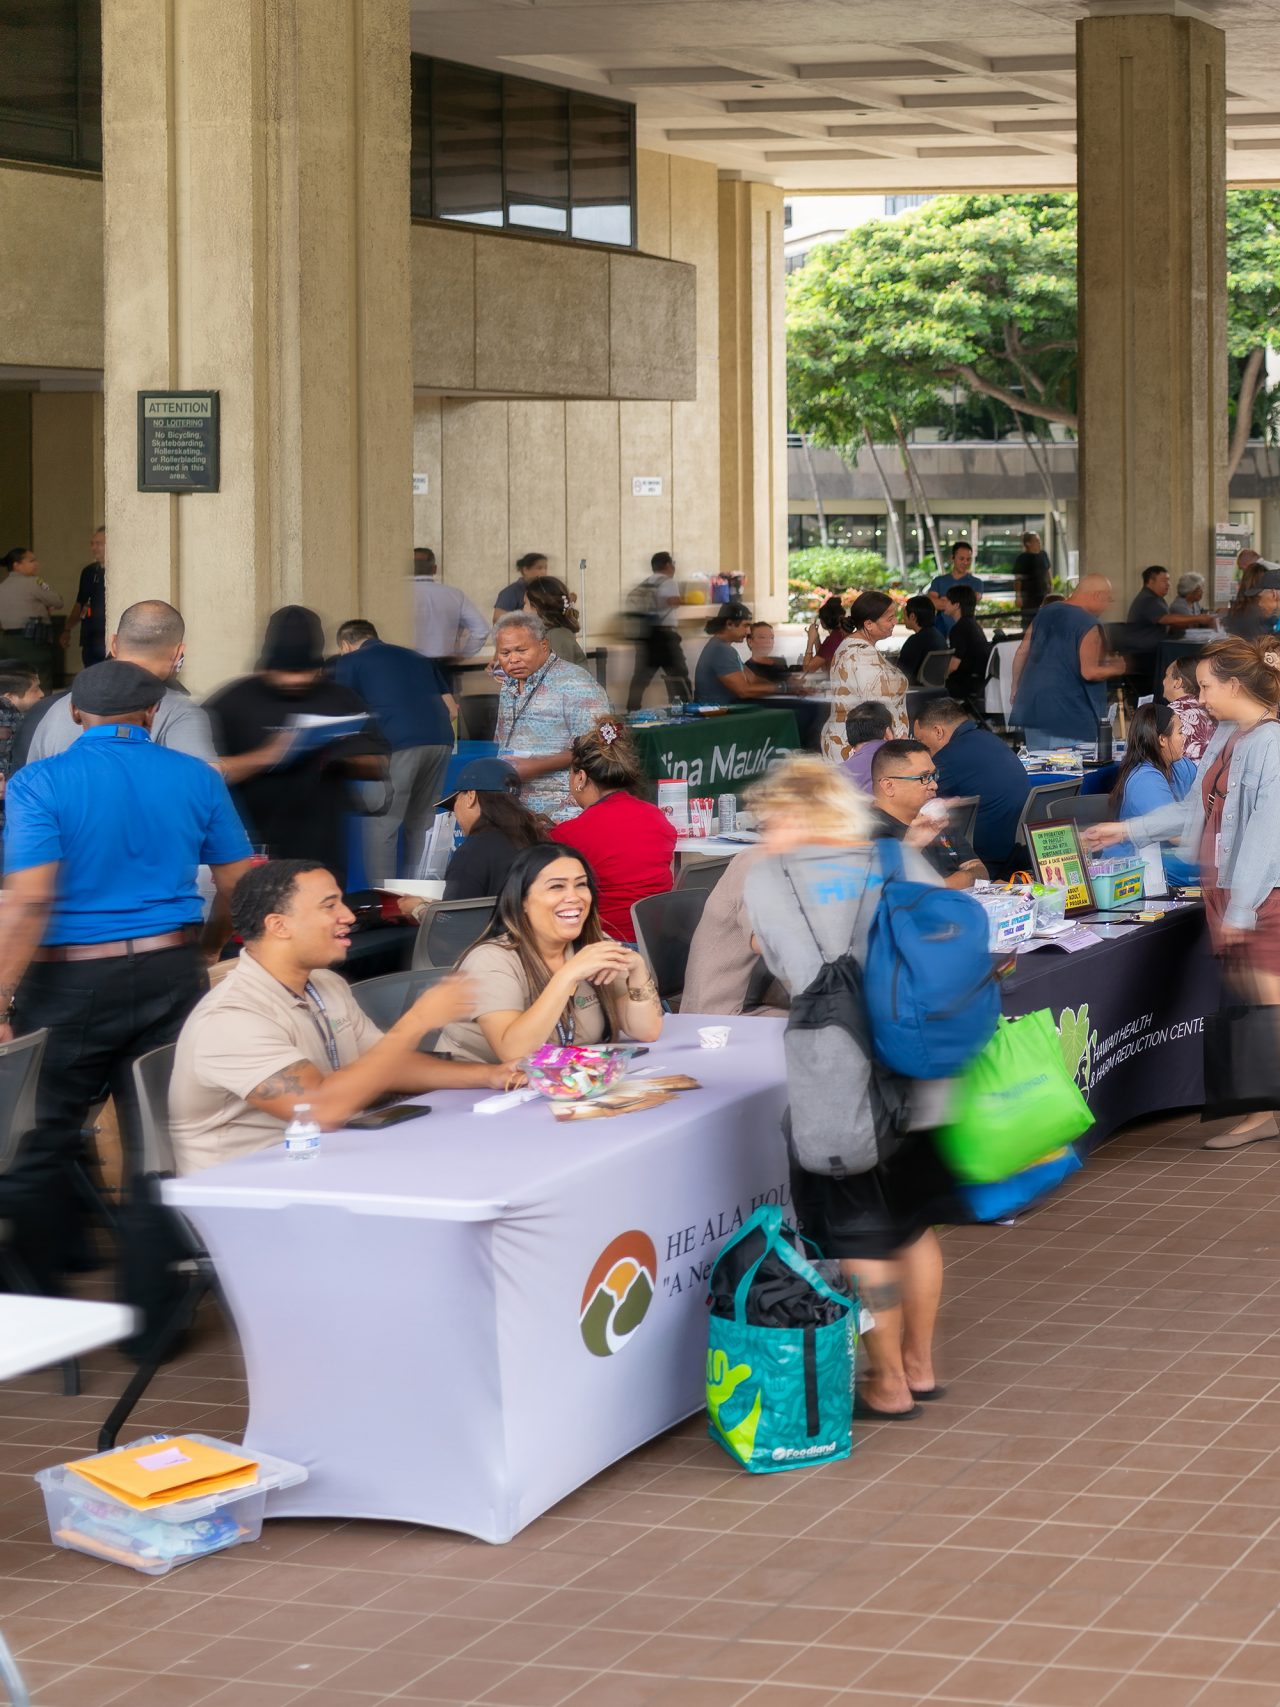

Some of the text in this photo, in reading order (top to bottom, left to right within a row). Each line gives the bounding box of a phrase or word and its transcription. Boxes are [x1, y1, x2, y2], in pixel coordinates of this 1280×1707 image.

[149, 402, 208, 413] ATTENTION
[153, 420, 203, 428] NO LOITERING
[168, 431, 201, 440] Bicycling,
[151, 440, 205, 448] Skateboarding,
[154, 448, 202, 456] Rollerskating,
[160, 456, 206, 465] Rollerblading
[661, 751, 703, 787] ina
[1119, 1012, 1154, 1043] HEALTH
[1089, 1016, 1205, 1088] & HARM REDUCTION CENTE
[665, 1225, 696, 1262] HE
[701, 1205, 743, 1246] ALA
[663, 1261, 714, 1297] "A Ne
[785, 1441, 836, 1458] Foodland
